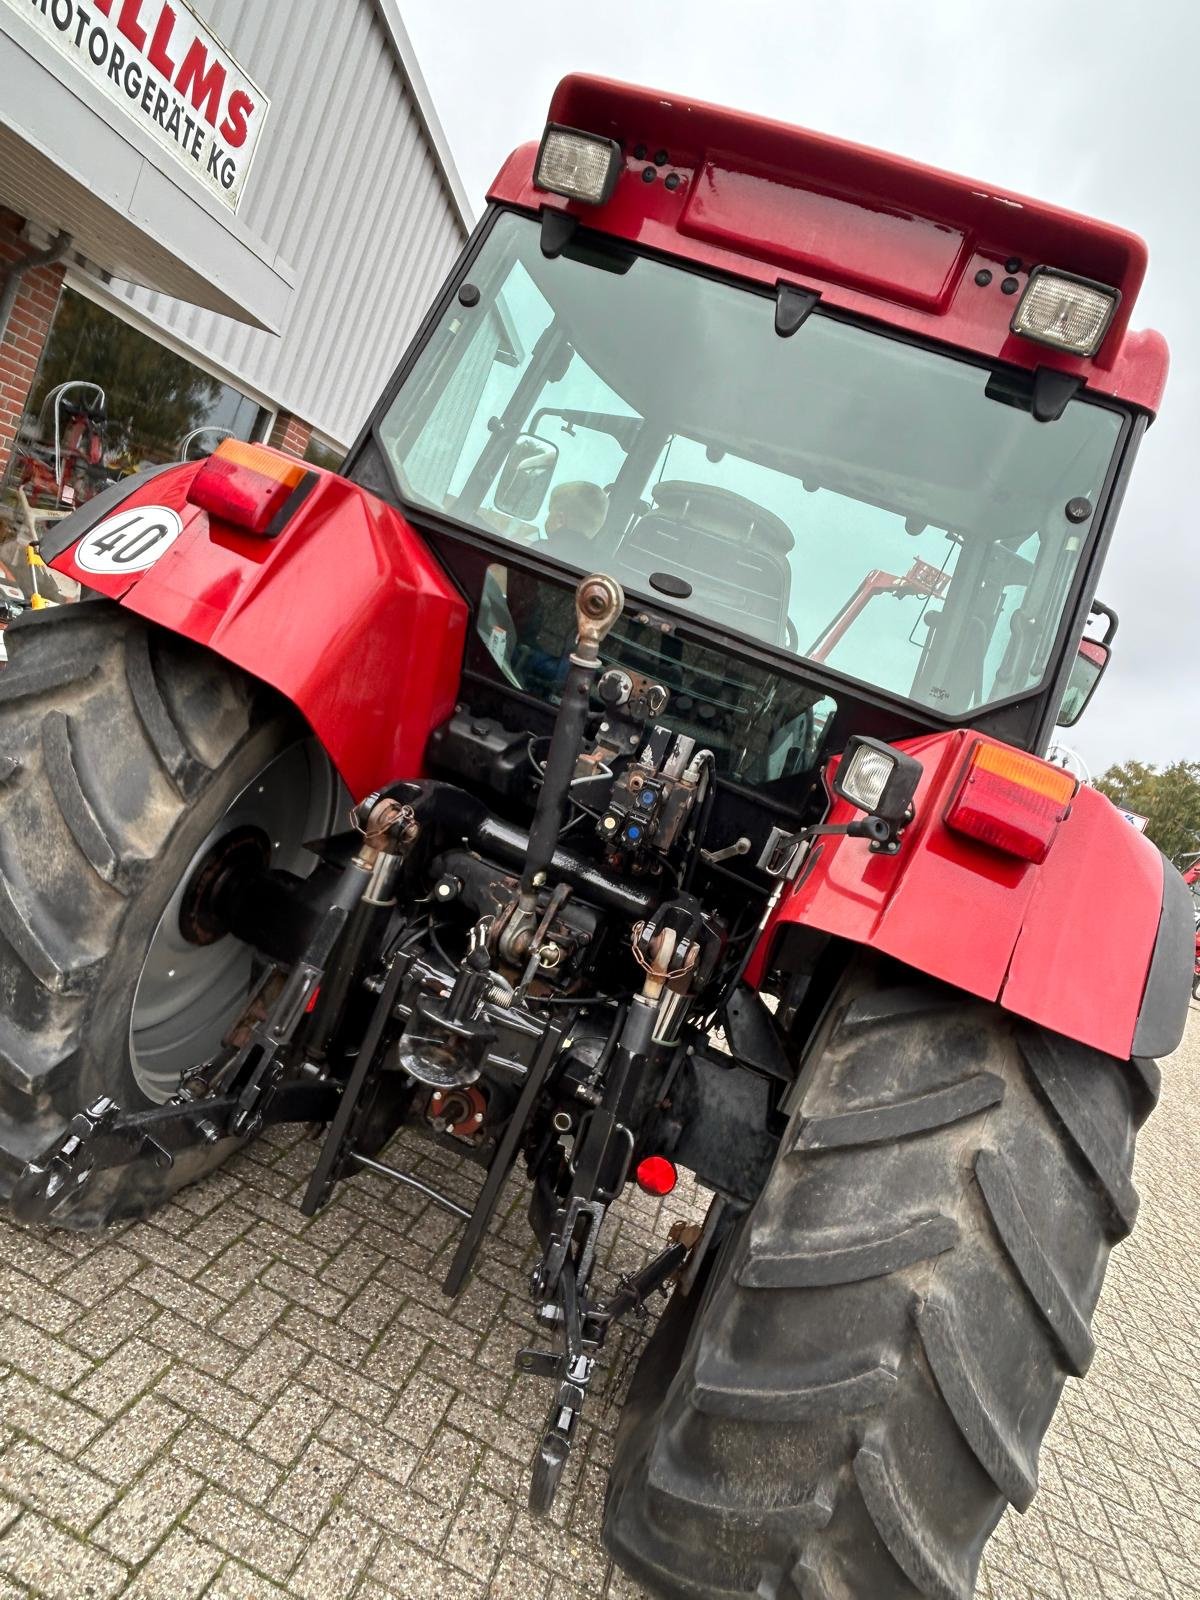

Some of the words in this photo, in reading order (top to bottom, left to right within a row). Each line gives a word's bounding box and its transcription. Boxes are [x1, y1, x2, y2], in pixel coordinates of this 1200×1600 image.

[91, 0, 255, 148] LLMS
[207, 141, 237, 189] KG
[90, 516, 168, 564] 40
